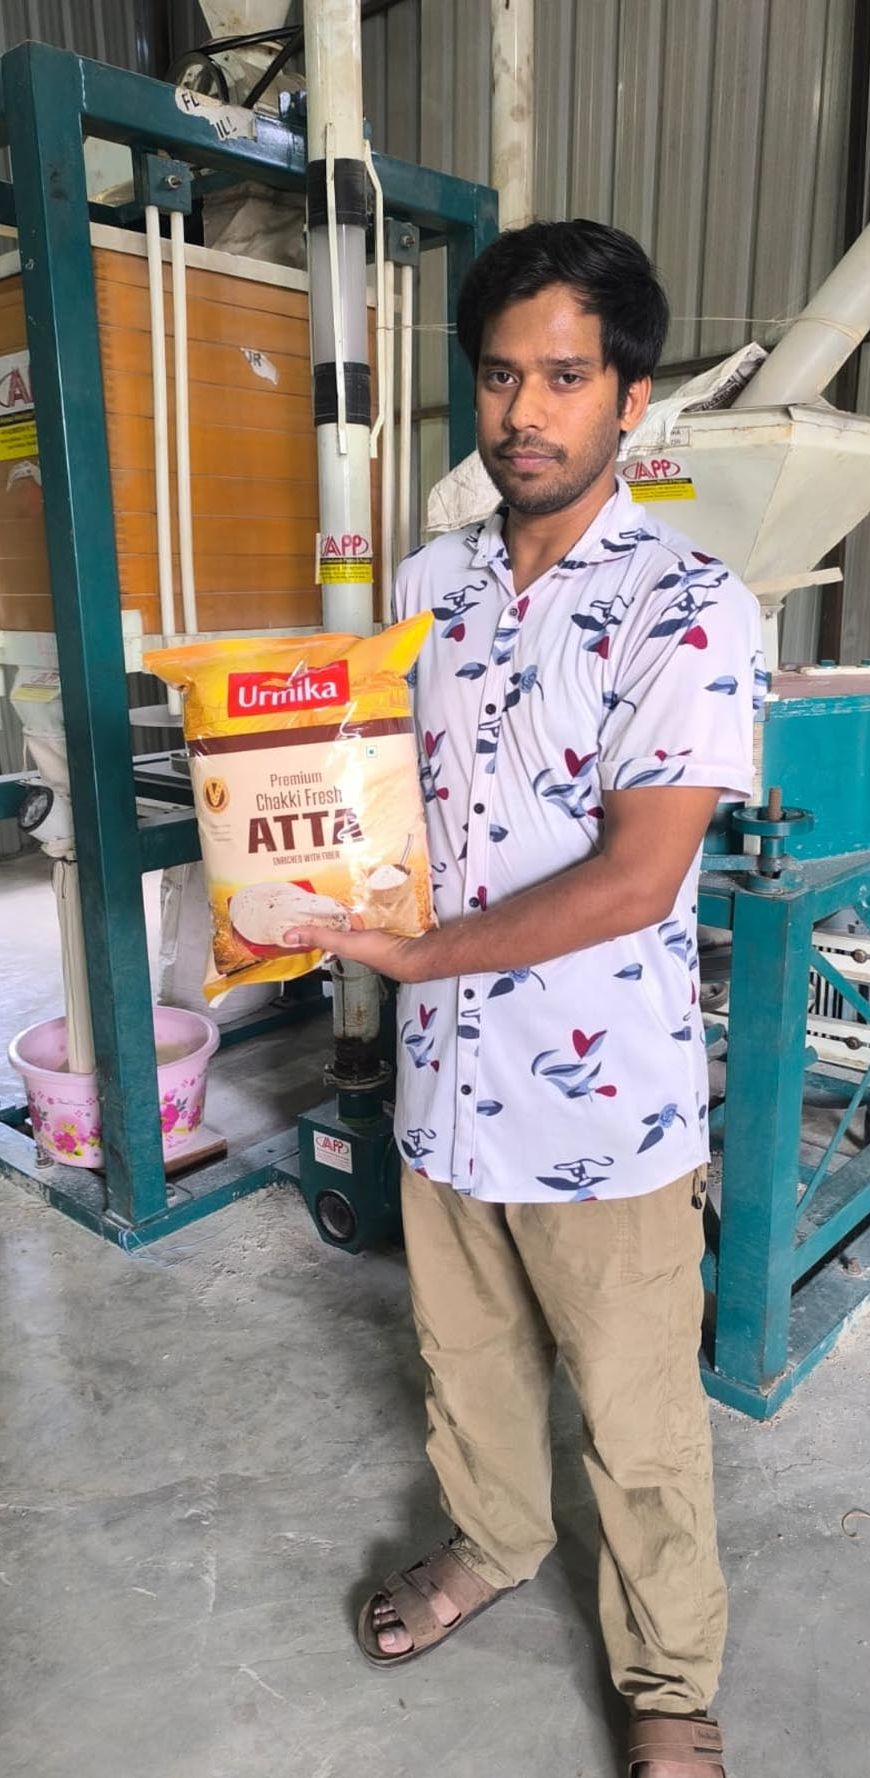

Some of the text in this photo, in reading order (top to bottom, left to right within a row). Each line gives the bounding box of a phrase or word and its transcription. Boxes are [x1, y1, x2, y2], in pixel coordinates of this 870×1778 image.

[238, 677, 338, 708] Urmika
[270, 771, 323, 788] Premium
[256, 785, 343, 812] Chakki Fresh
[248, 808, 365, 854] ATTA
